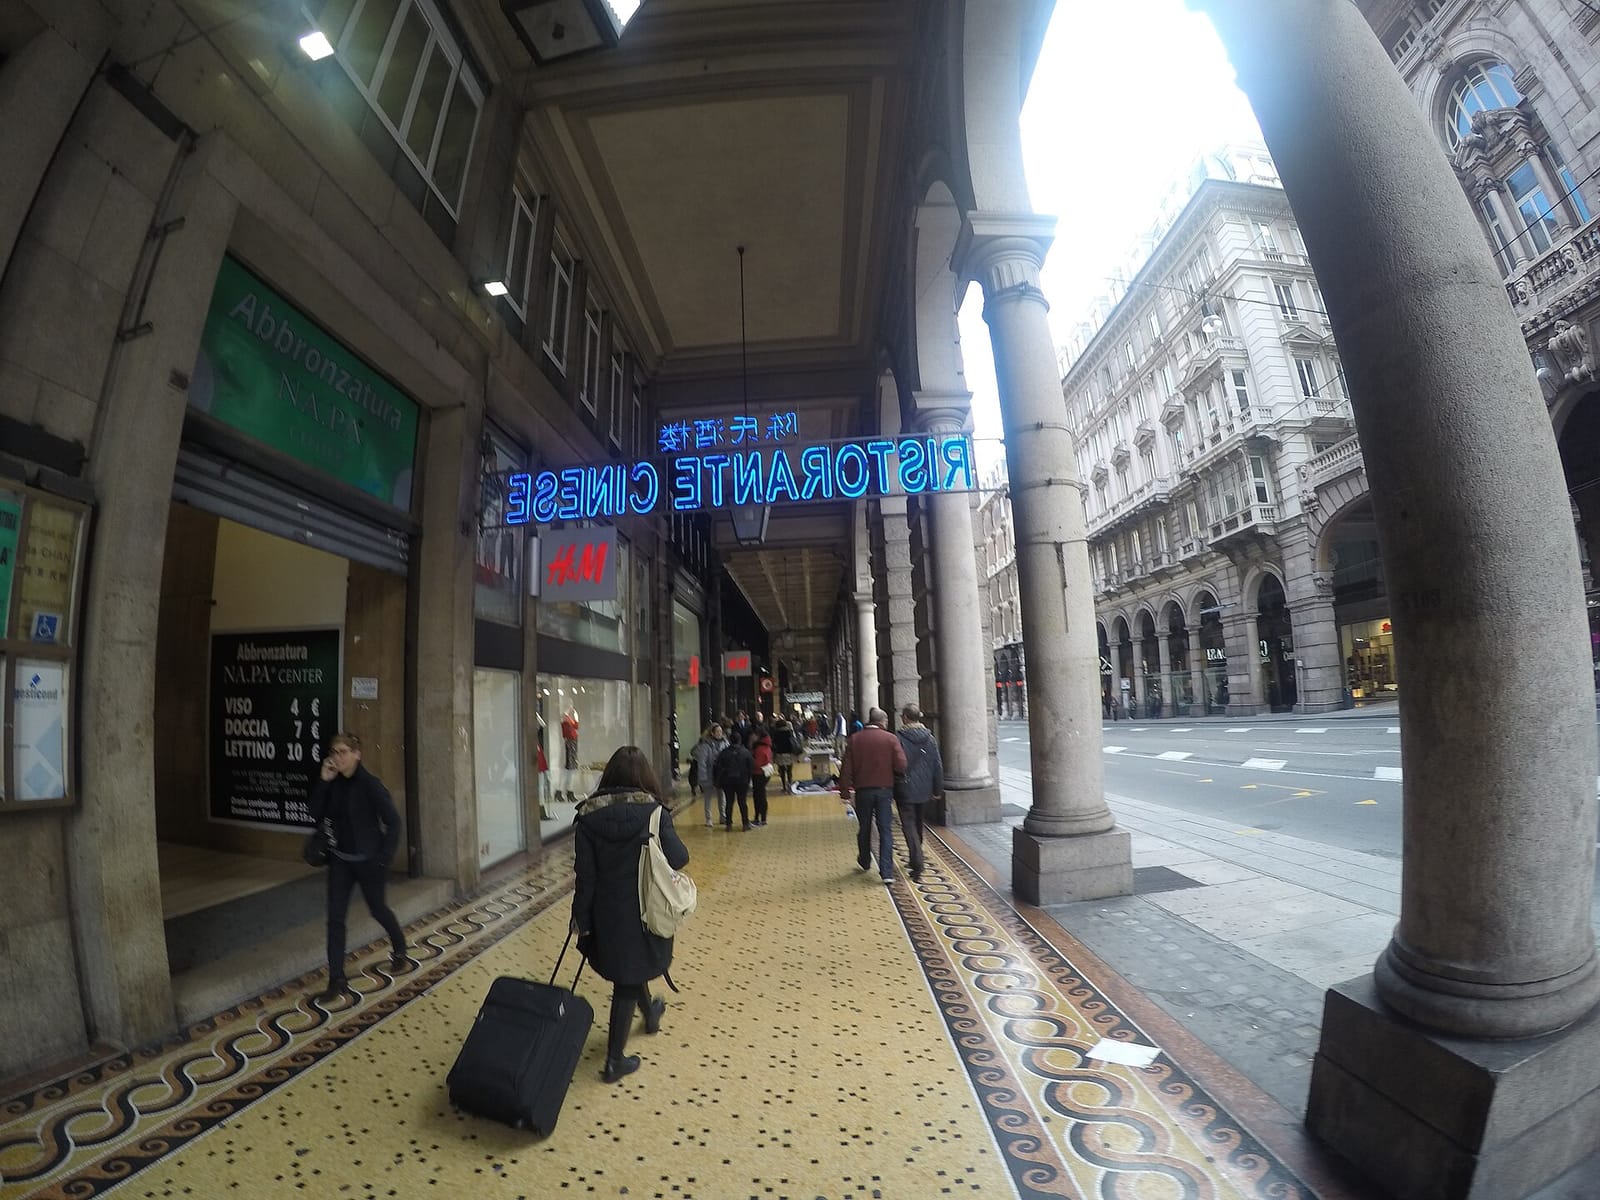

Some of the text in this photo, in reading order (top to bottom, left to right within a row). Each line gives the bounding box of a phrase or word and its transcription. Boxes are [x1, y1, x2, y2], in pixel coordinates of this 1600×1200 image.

[229, 292, 402, 431] Abbronzatura
[546, 541, 608, 586] H&M
[237, 642, 308, 661] Abbronzatura
[277, 668, 324, 685] CENTER
[225, 697, 320, 717] VISO 4 €
[225, 718, 320, 739] DOCCIA 7 €
[225, 740, 321, 762] LETTINO 10 €
